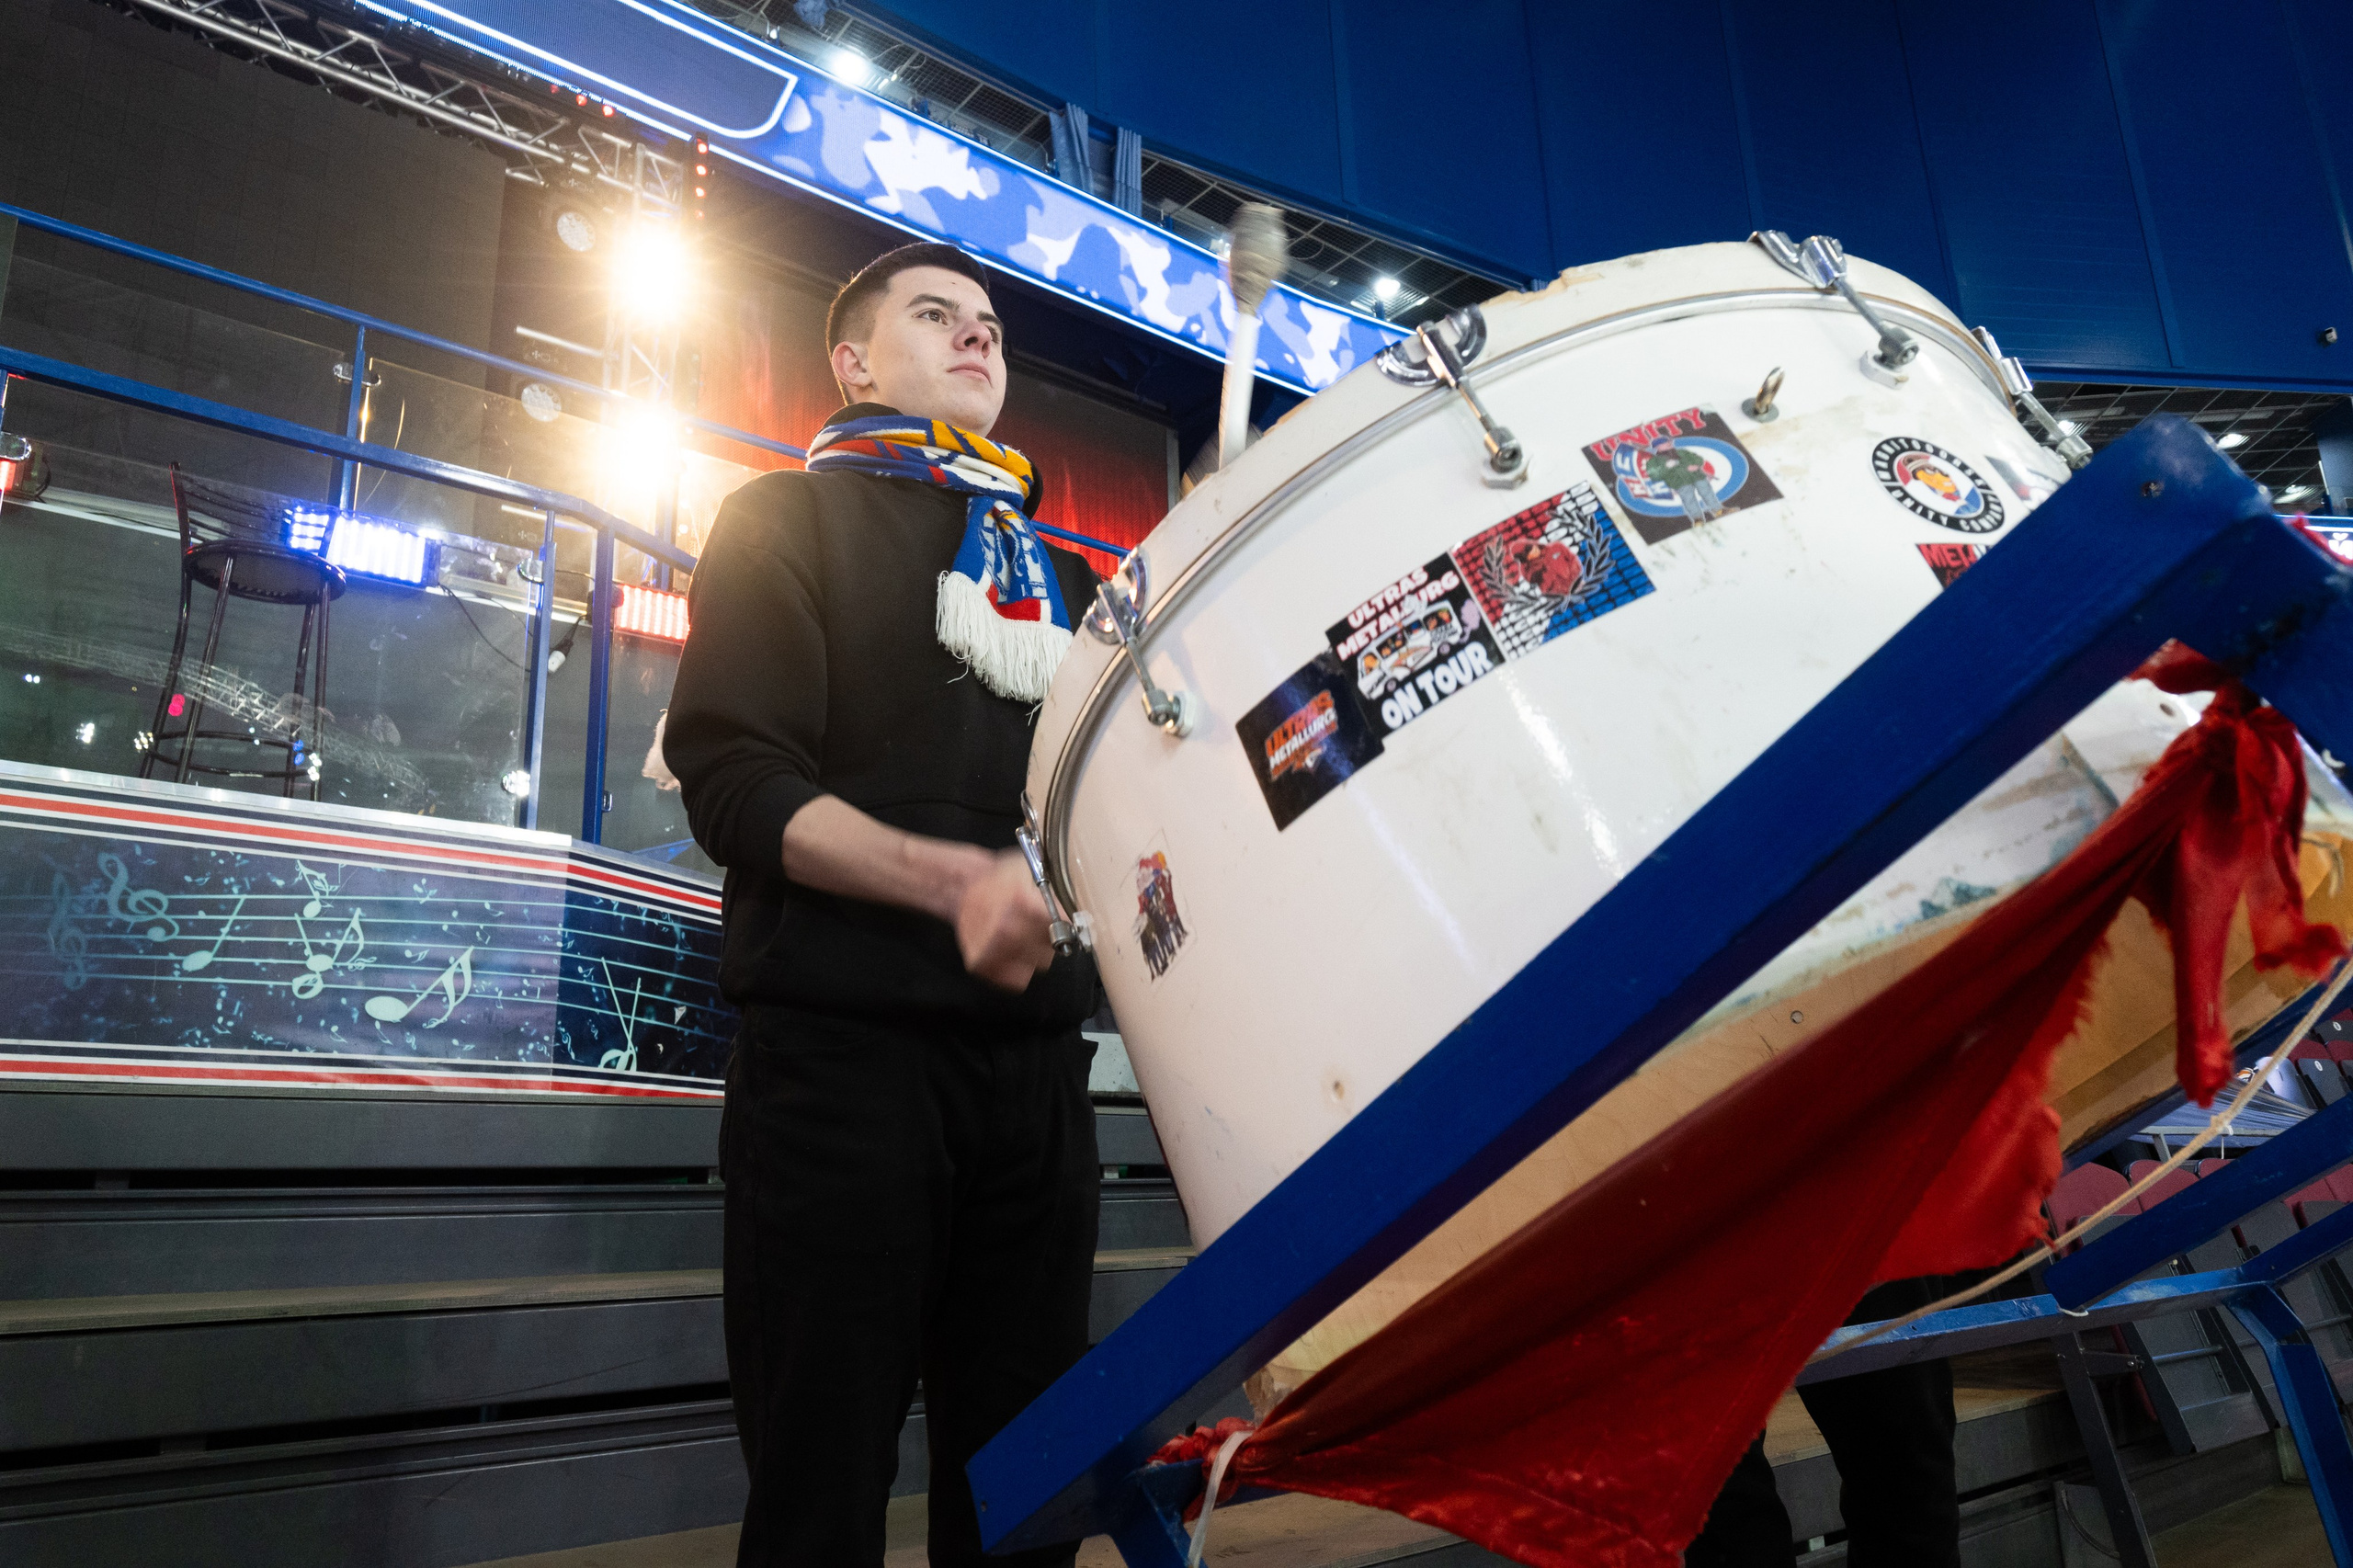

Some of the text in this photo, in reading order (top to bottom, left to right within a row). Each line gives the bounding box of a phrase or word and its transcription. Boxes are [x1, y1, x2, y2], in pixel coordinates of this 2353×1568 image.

[1590, 407, 1706, 461] UNITY
[1336, 570, 1460, 662] METALURG
[1347, 566, 1428, 629] ULTRAS
[1381, 642, 1494, 730] ON TOUR
